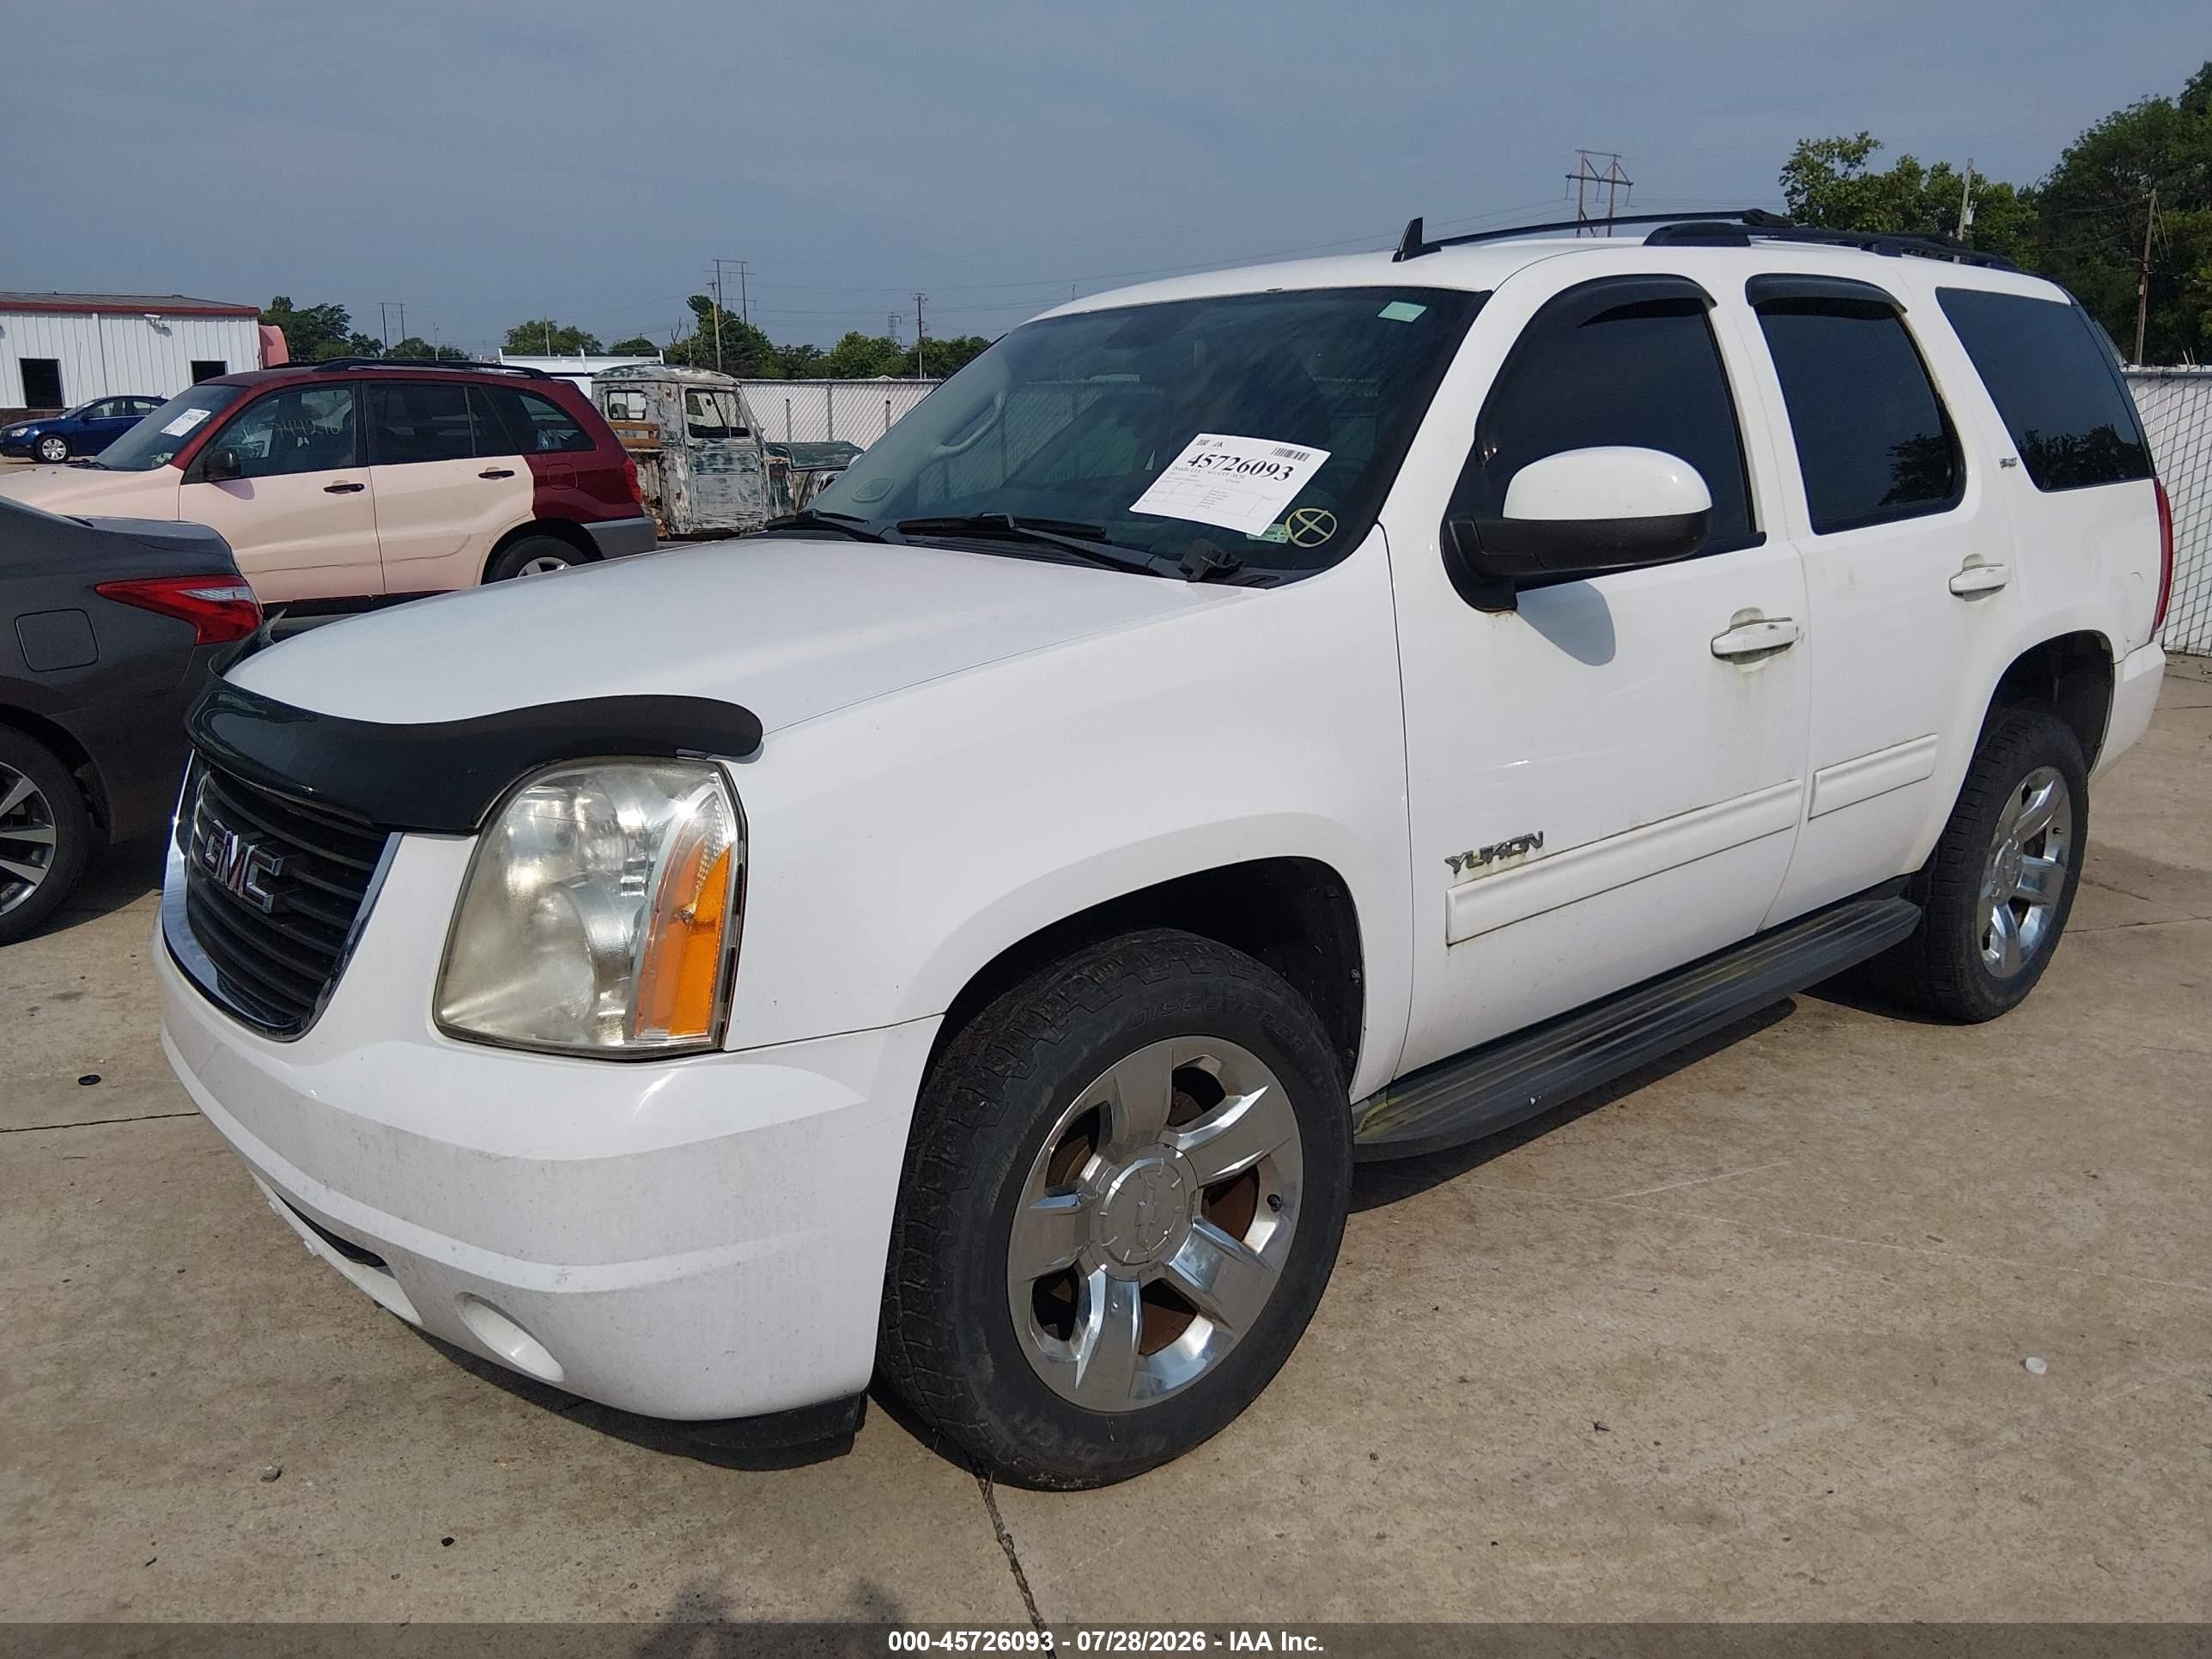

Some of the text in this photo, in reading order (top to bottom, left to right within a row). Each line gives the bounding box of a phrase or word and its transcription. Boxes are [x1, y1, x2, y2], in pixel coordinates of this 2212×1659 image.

[1188, 453, 1293, 481] 45726093
[203, 819, 284, 914] GMC
[1444, 830, 1543, 872] YUKON
